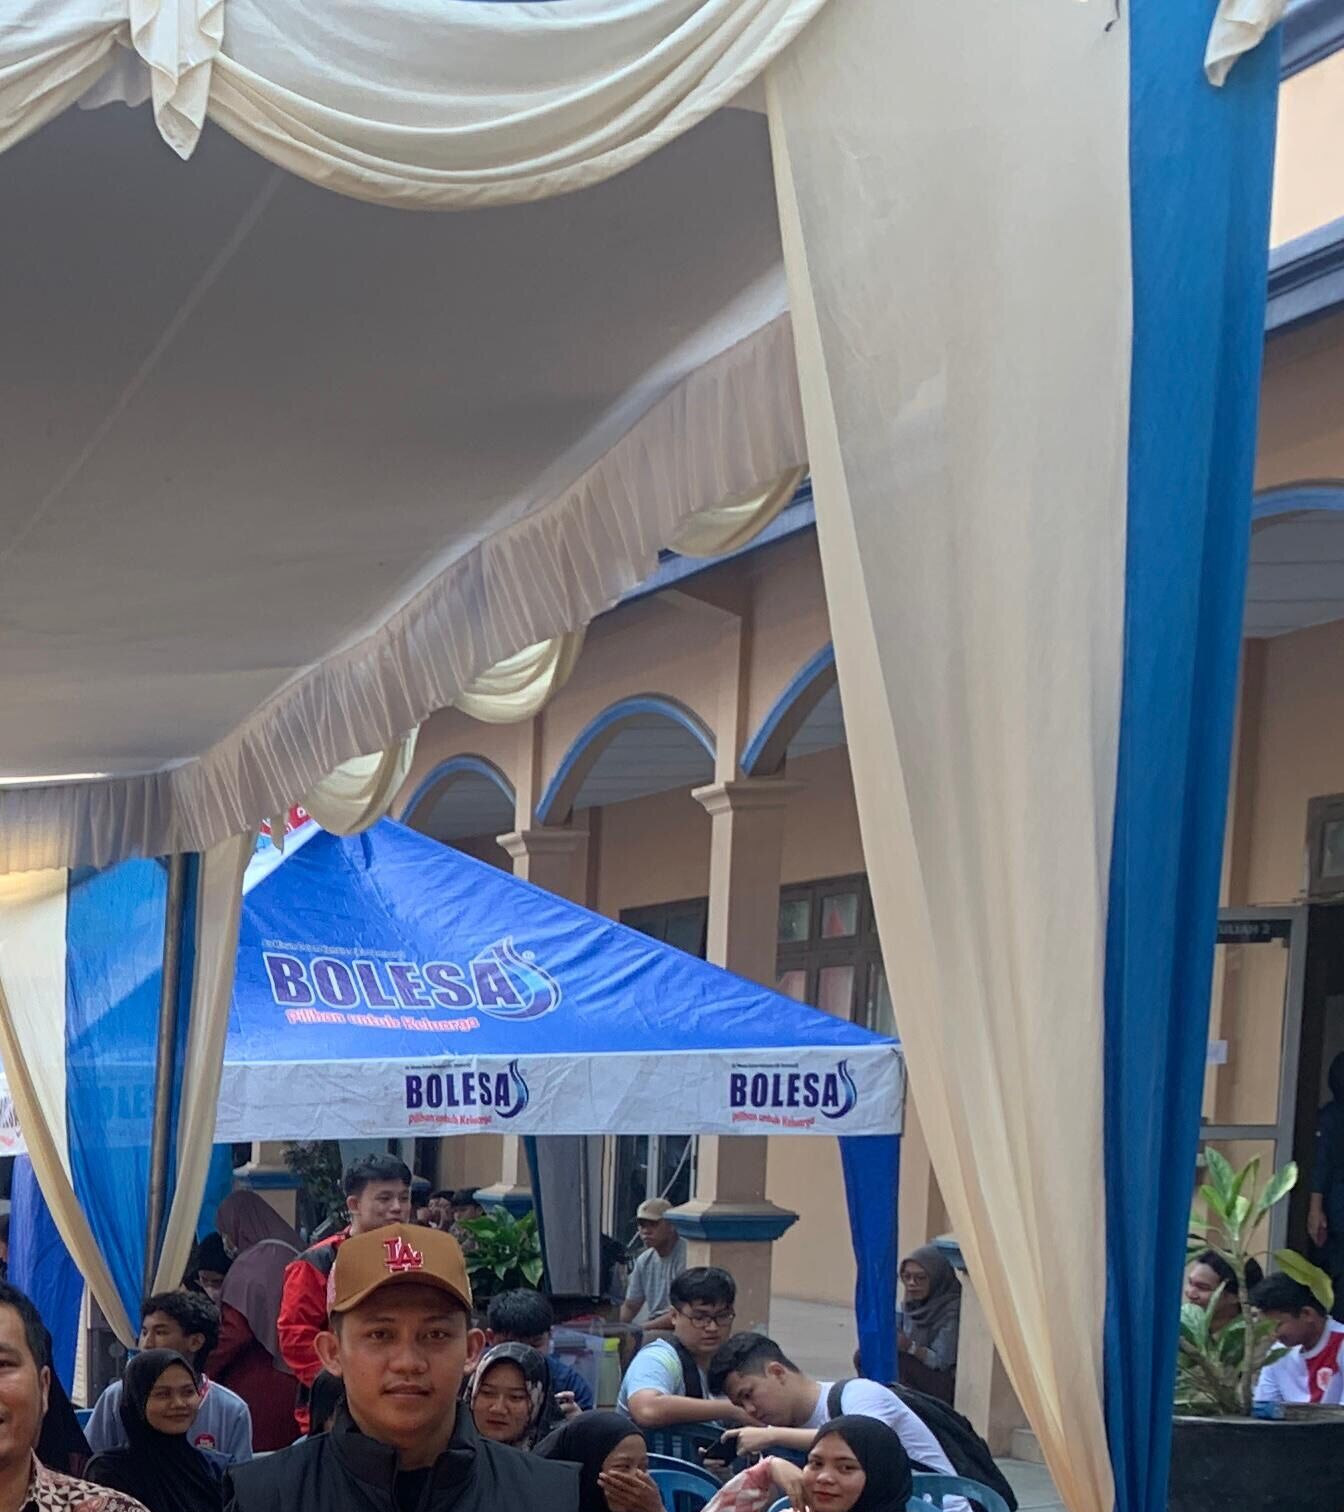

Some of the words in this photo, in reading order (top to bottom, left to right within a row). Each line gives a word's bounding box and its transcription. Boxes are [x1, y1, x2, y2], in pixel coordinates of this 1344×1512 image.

[264, 953, 527, 1009] BOLESA
[406, 1072, 511, 1109] BOLESA
[730, 1072, 839, 1108] BOLESA
